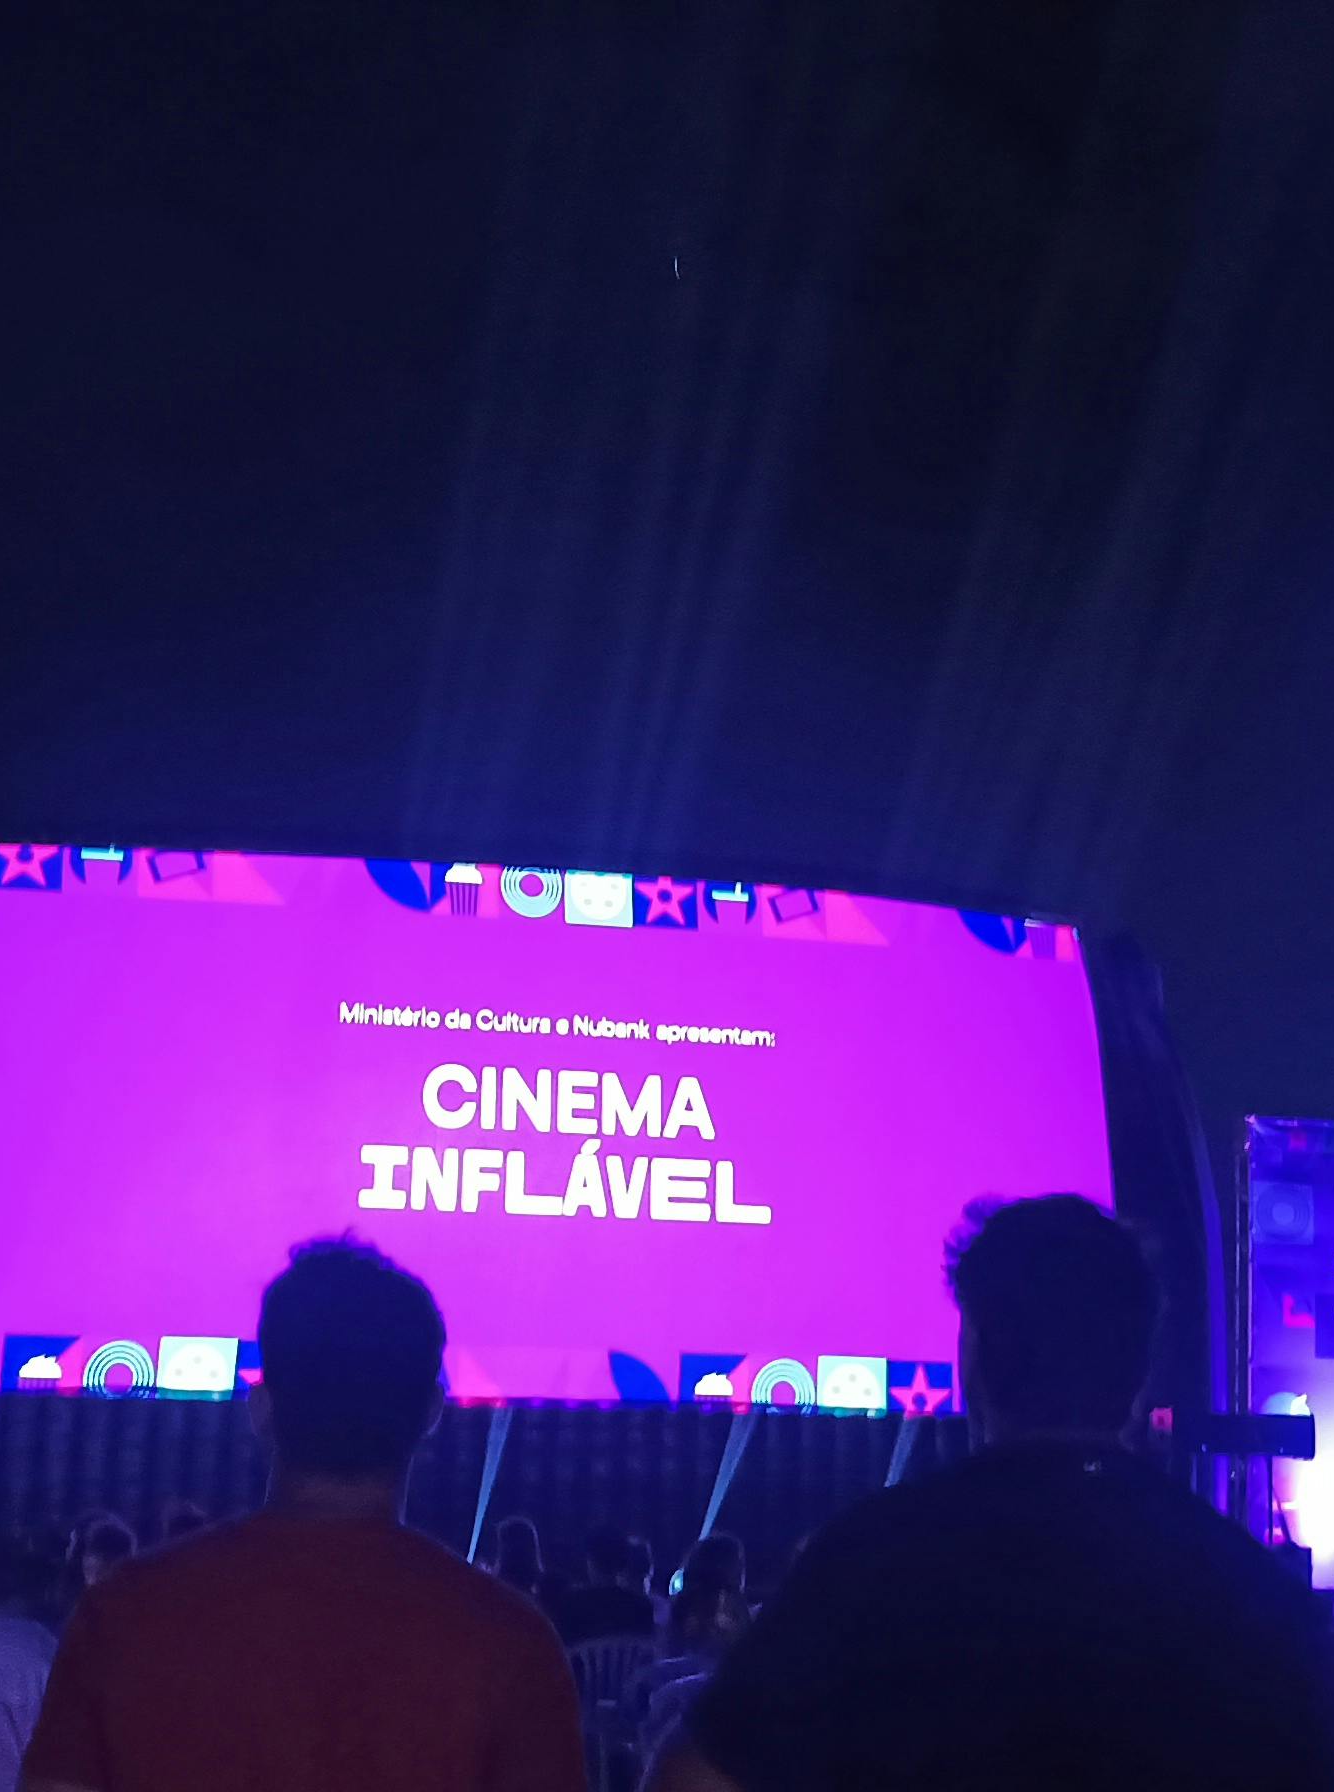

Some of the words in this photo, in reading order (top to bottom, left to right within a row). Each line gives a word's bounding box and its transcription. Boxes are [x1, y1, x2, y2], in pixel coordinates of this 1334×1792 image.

[339, 1001, 440, 1029] Ministério
[445, 1008, 471, 1030] da
[476, 1008, 551, 1034] Cultura
[556, 1018, 569, 1035] e
[573, 1014, 650, 1040] Nubank
[422, 1063, 716, 1141] CINEMA
[358, 1139, 772, 1225] INFLÁVEL
